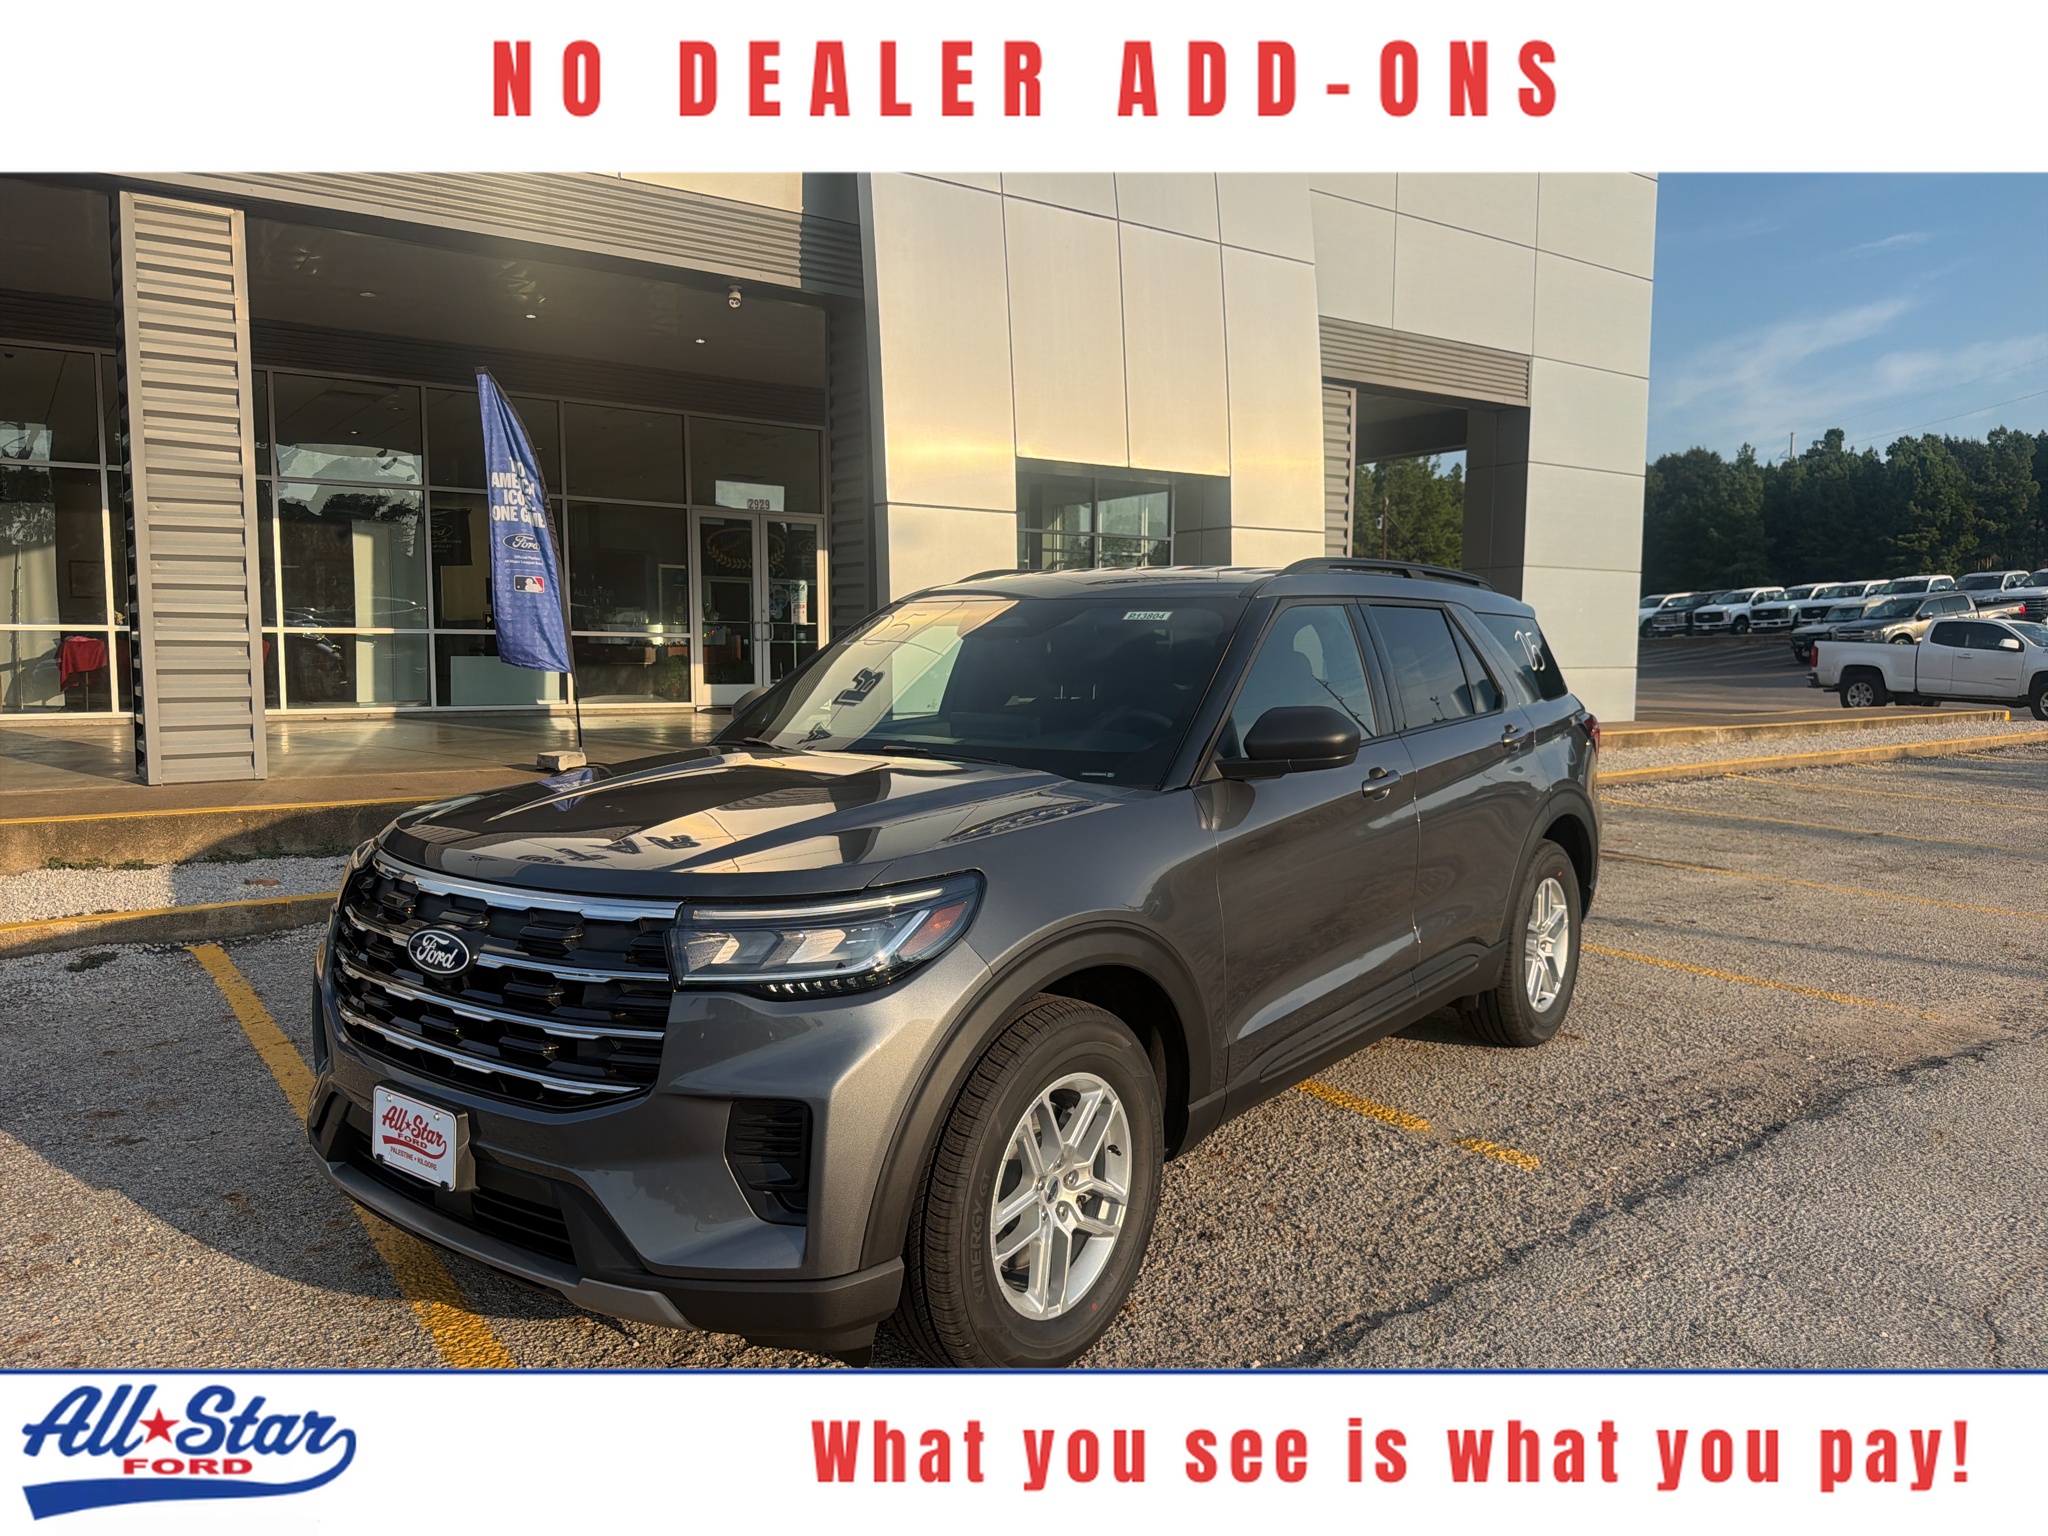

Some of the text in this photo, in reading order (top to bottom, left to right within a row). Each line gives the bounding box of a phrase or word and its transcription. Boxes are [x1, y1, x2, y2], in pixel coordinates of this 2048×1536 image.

[491, 505, 518, 522] ONE
[747, 498, 771, 510] 2929
[416, 934, 459, 969] Ford
[381, 1105, 446, 1147] All Star
[397, 1132, 428, 1149] FORD
[390, 1146, 438, 1171] PALESTINE KILGORE
